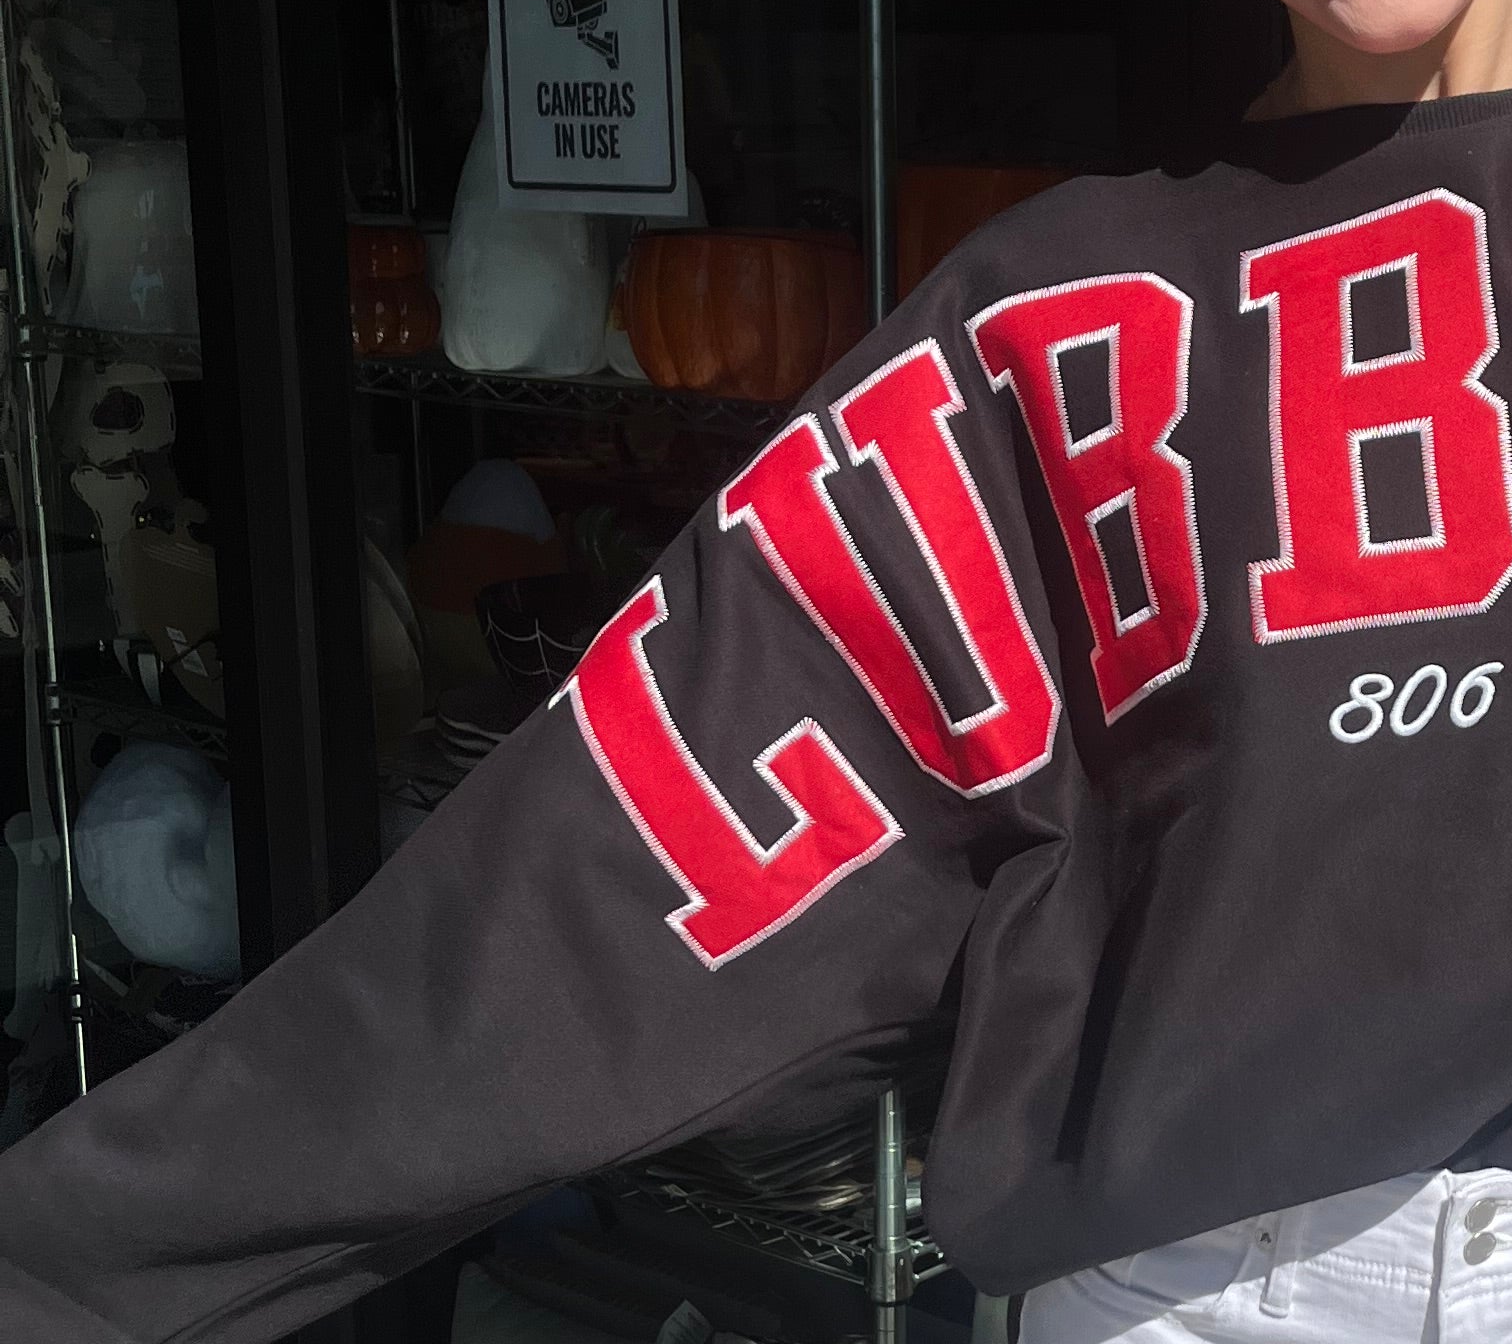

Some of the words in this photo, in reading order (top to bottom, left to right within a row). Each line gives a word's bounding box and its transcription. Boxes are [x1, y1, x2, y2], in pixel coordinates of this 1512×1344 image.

[536, 81, 636, 118] CAMERAS
[554, 124, 576, 159] IN
[581, 124, 621, 159] USE
[1328, 661, 1505, 744] 806
